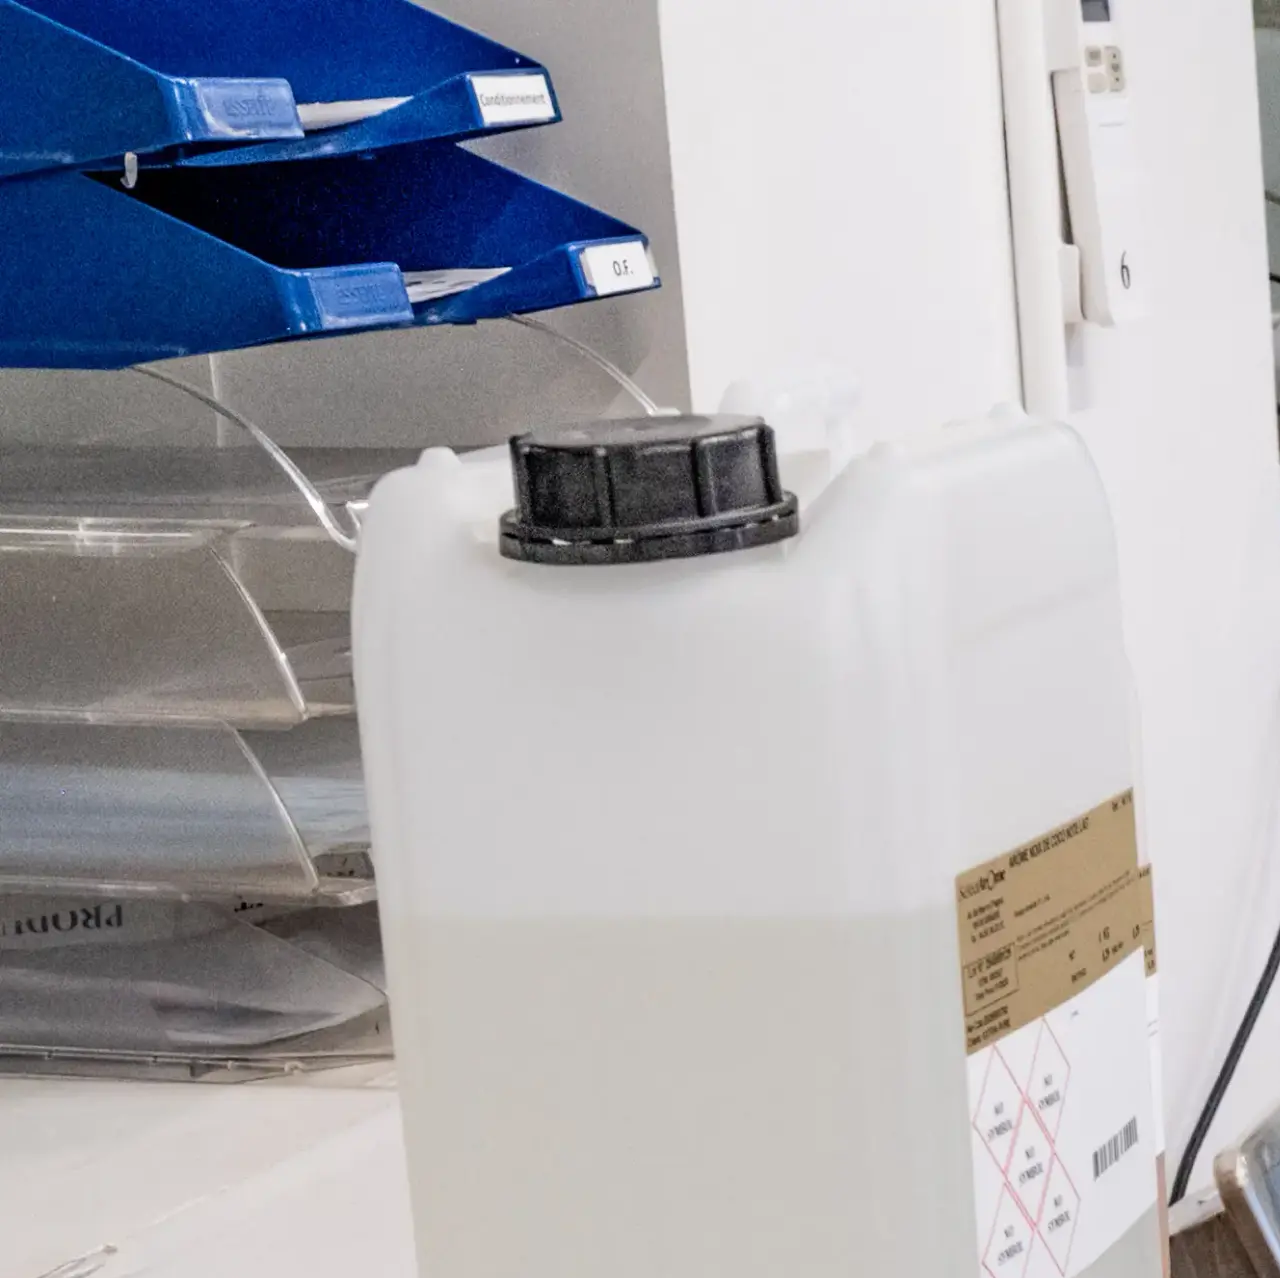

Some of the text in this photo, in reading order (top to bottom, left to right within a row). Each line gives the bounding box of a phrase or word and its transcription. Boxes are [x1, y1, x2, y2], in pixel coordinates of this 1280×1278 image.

[479, 93, 547, 107] Conditionnement
[612, 259, 634, 277] O.F.
[1120, 250, 1131, 290] 6
